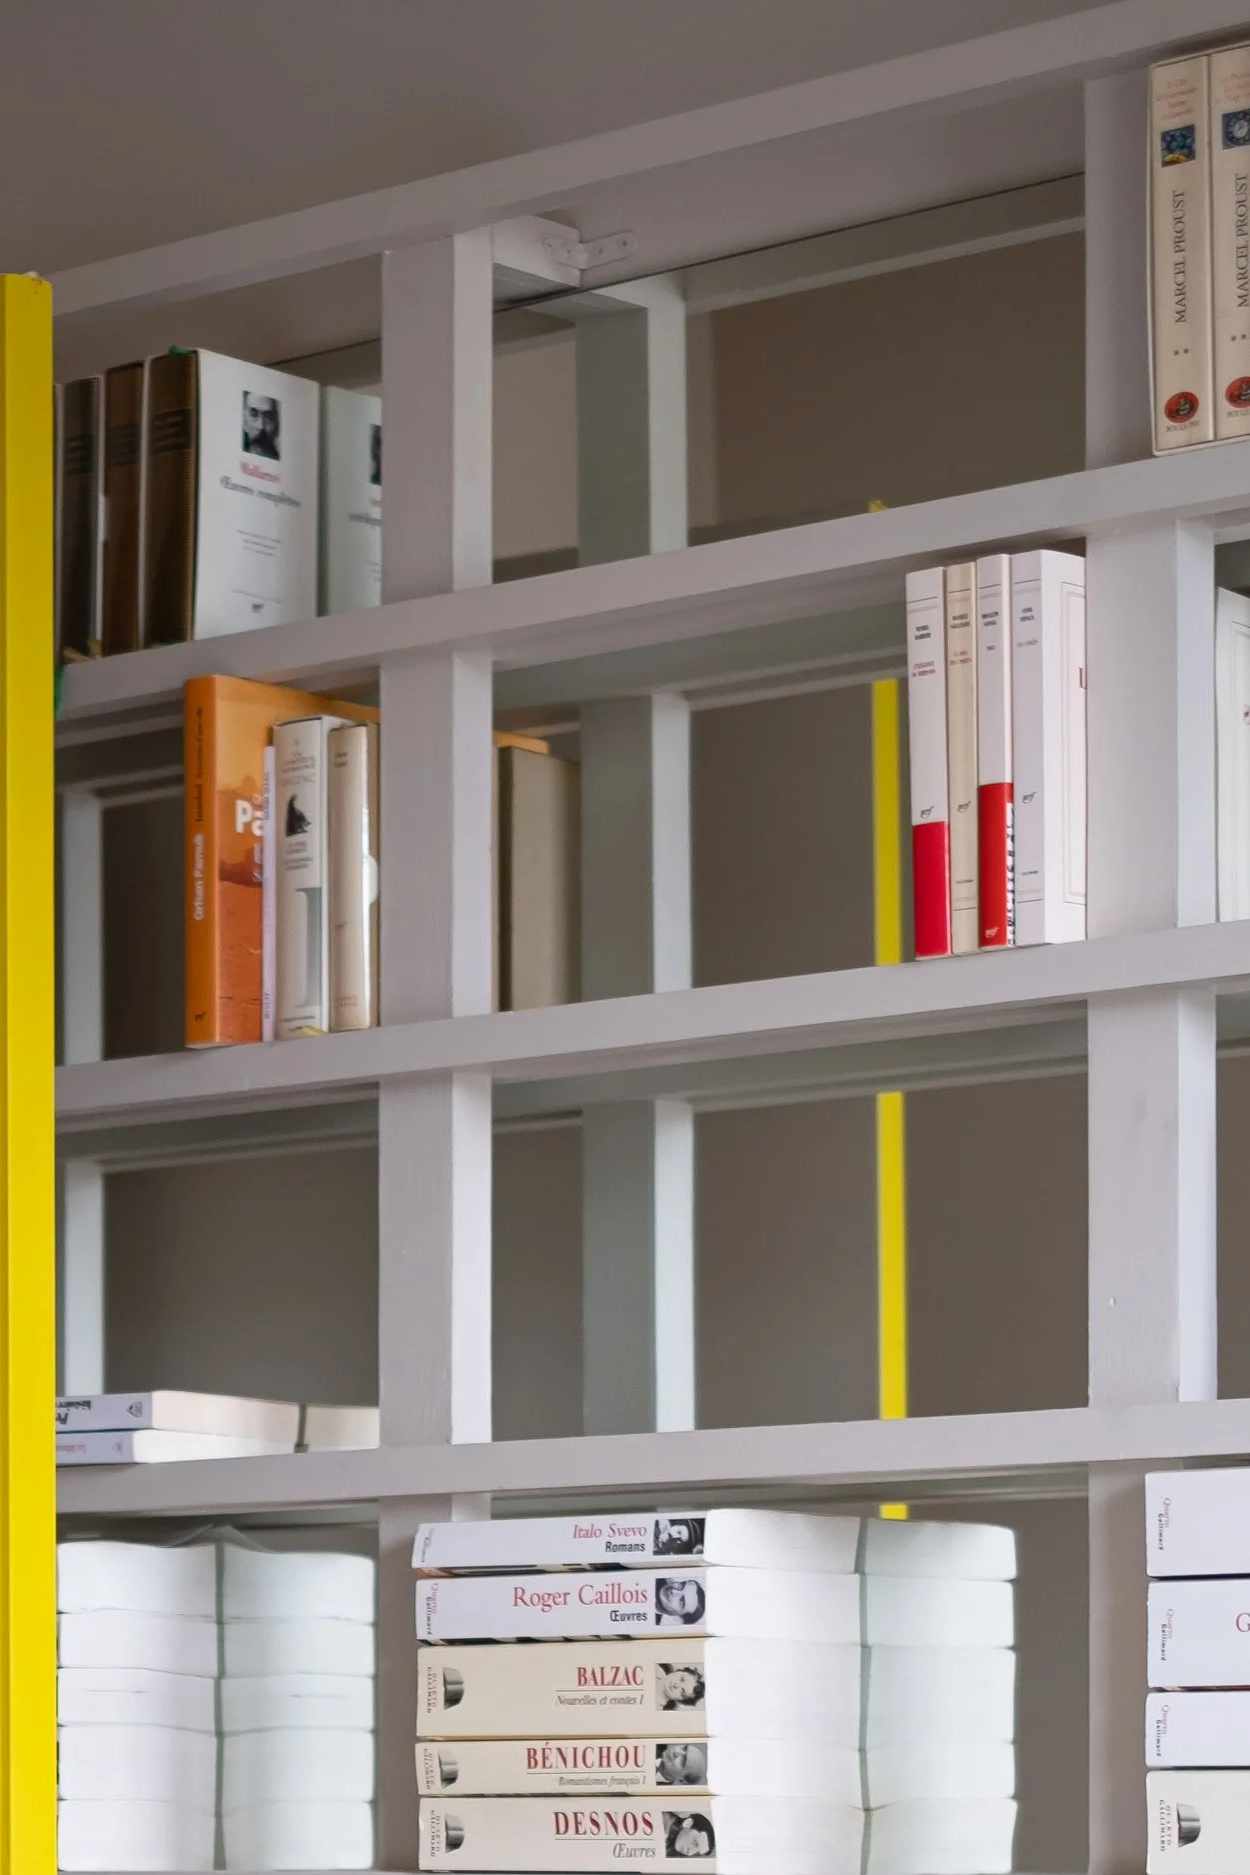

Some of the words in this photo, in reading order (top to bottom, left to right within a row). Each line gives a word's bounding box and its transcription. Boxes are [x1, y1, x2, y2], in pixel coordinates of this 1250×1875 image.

[1234, 174, 1249, 238] PROUST
[1172, 189, 1186, 254] PROUST
[1235, 240, 1249, 308] MARCEL
[1173, 256, 1187, 324] MARCEL
[572, 1524, 602, 1540] Italo
[608, 1523, 647, 1539] Svevo
[604, 1541, 646, 1554] Romans
[512, 1586, 571, 1612] Roger
[578, 1583, 648, 1606] Caillois
[609, 1610, 648, 1623] Œuvres
[576, 1666, 645, 1688] BALZAC
[526, 1742, 646, 1770] BÉNICHOU
[553, 1810, 654, 1836] DESNOS
[613, 1844, 656, 1860] Œuvres
